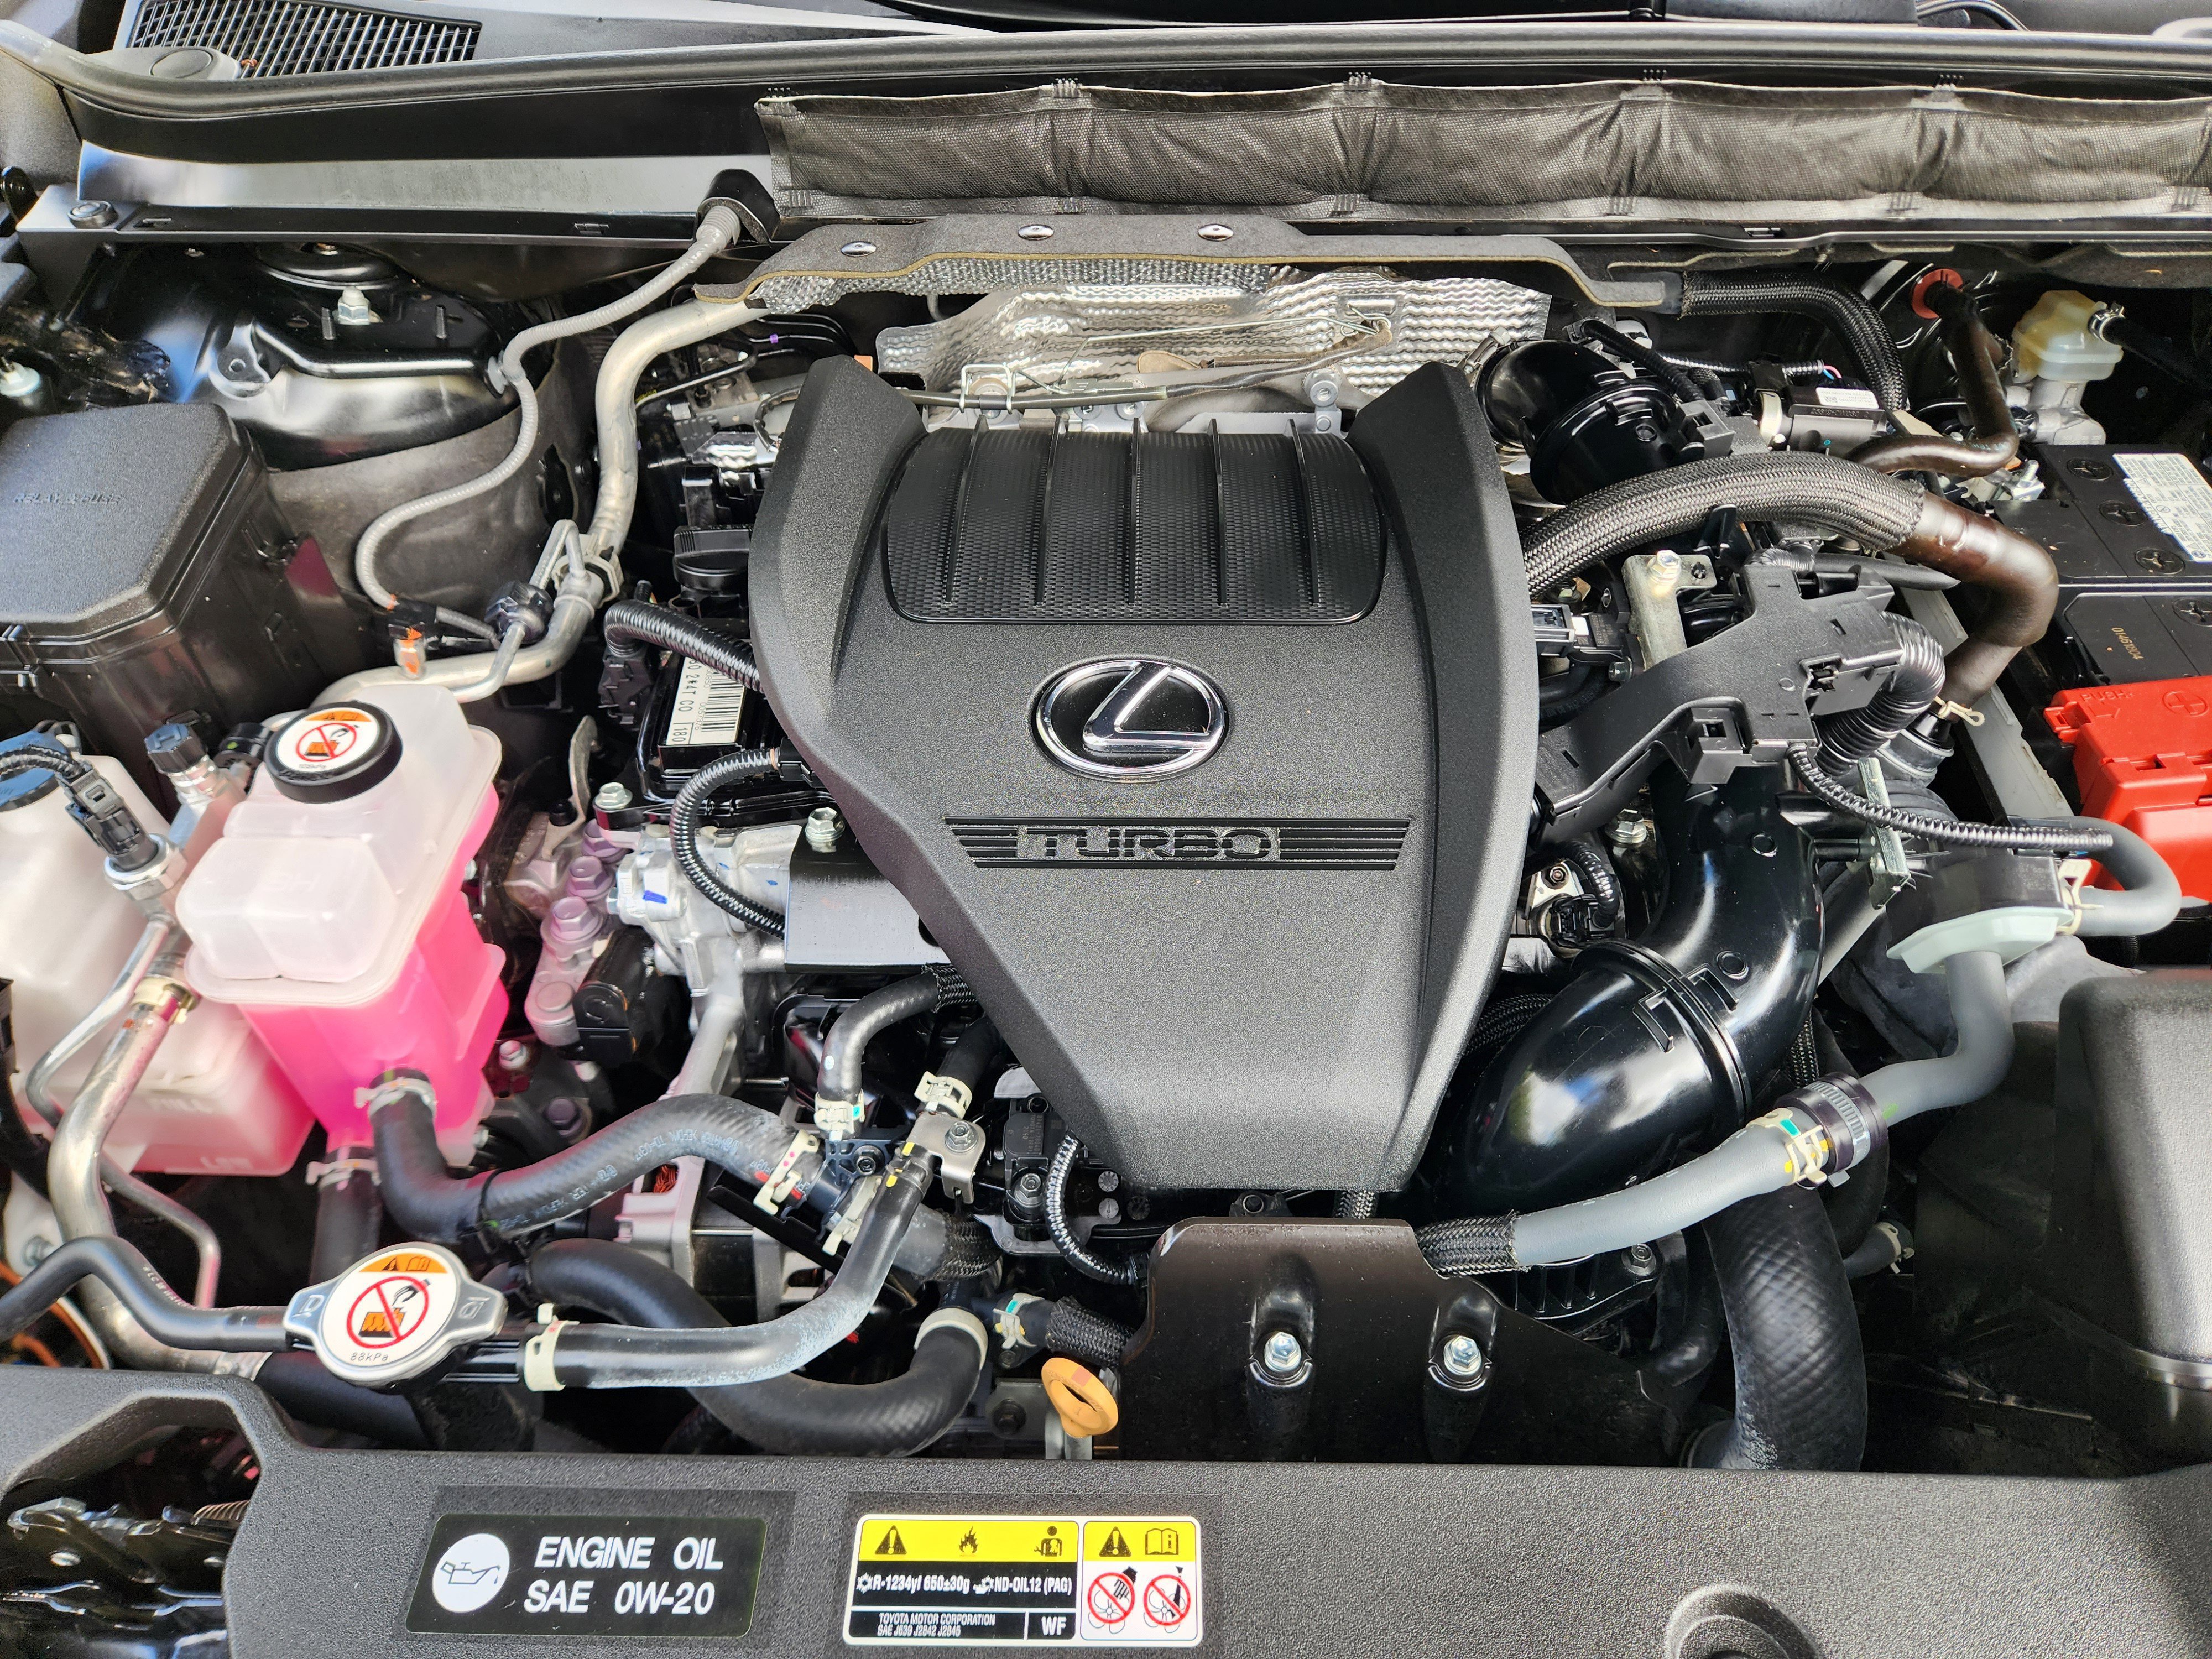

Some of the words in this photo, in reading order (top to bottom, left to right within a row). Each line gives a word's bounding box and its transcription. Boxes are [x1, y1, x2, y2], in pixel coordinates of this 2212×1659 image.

[2111, 627, 2144, 660] 01461804
[2079, 689, 2127, 702] PUSH
[671, 727, 688, 742] 180
[1023, 827, 1275, 860] TURBO
[349, 1352, 388, 1363] 88kPa
[534, 1536, 654, 1569] ENGINE
[673, 1537, 724, 1571] OIL
[873, 1574, 922, 1594] R-1234yf
[923, 1574, 971, 1594] 650±30g
[994, 1576, 1042, 1593] ND-OIL12
[1043, 1576, 1072, 1595] (PAG)
[523, 1579, 594, 1613] SAE
[614, 1580, 715, 1615] 0W-20
[879, 1613, 909, 1625] TOYOTA
[910, 1613, 939, 1625] MOTOR
[940, 1613, 996, 1626] CORPORATION
[1041, 1616, 1067, 1636] WF
[877, 1624, 893, 1637] SAE
